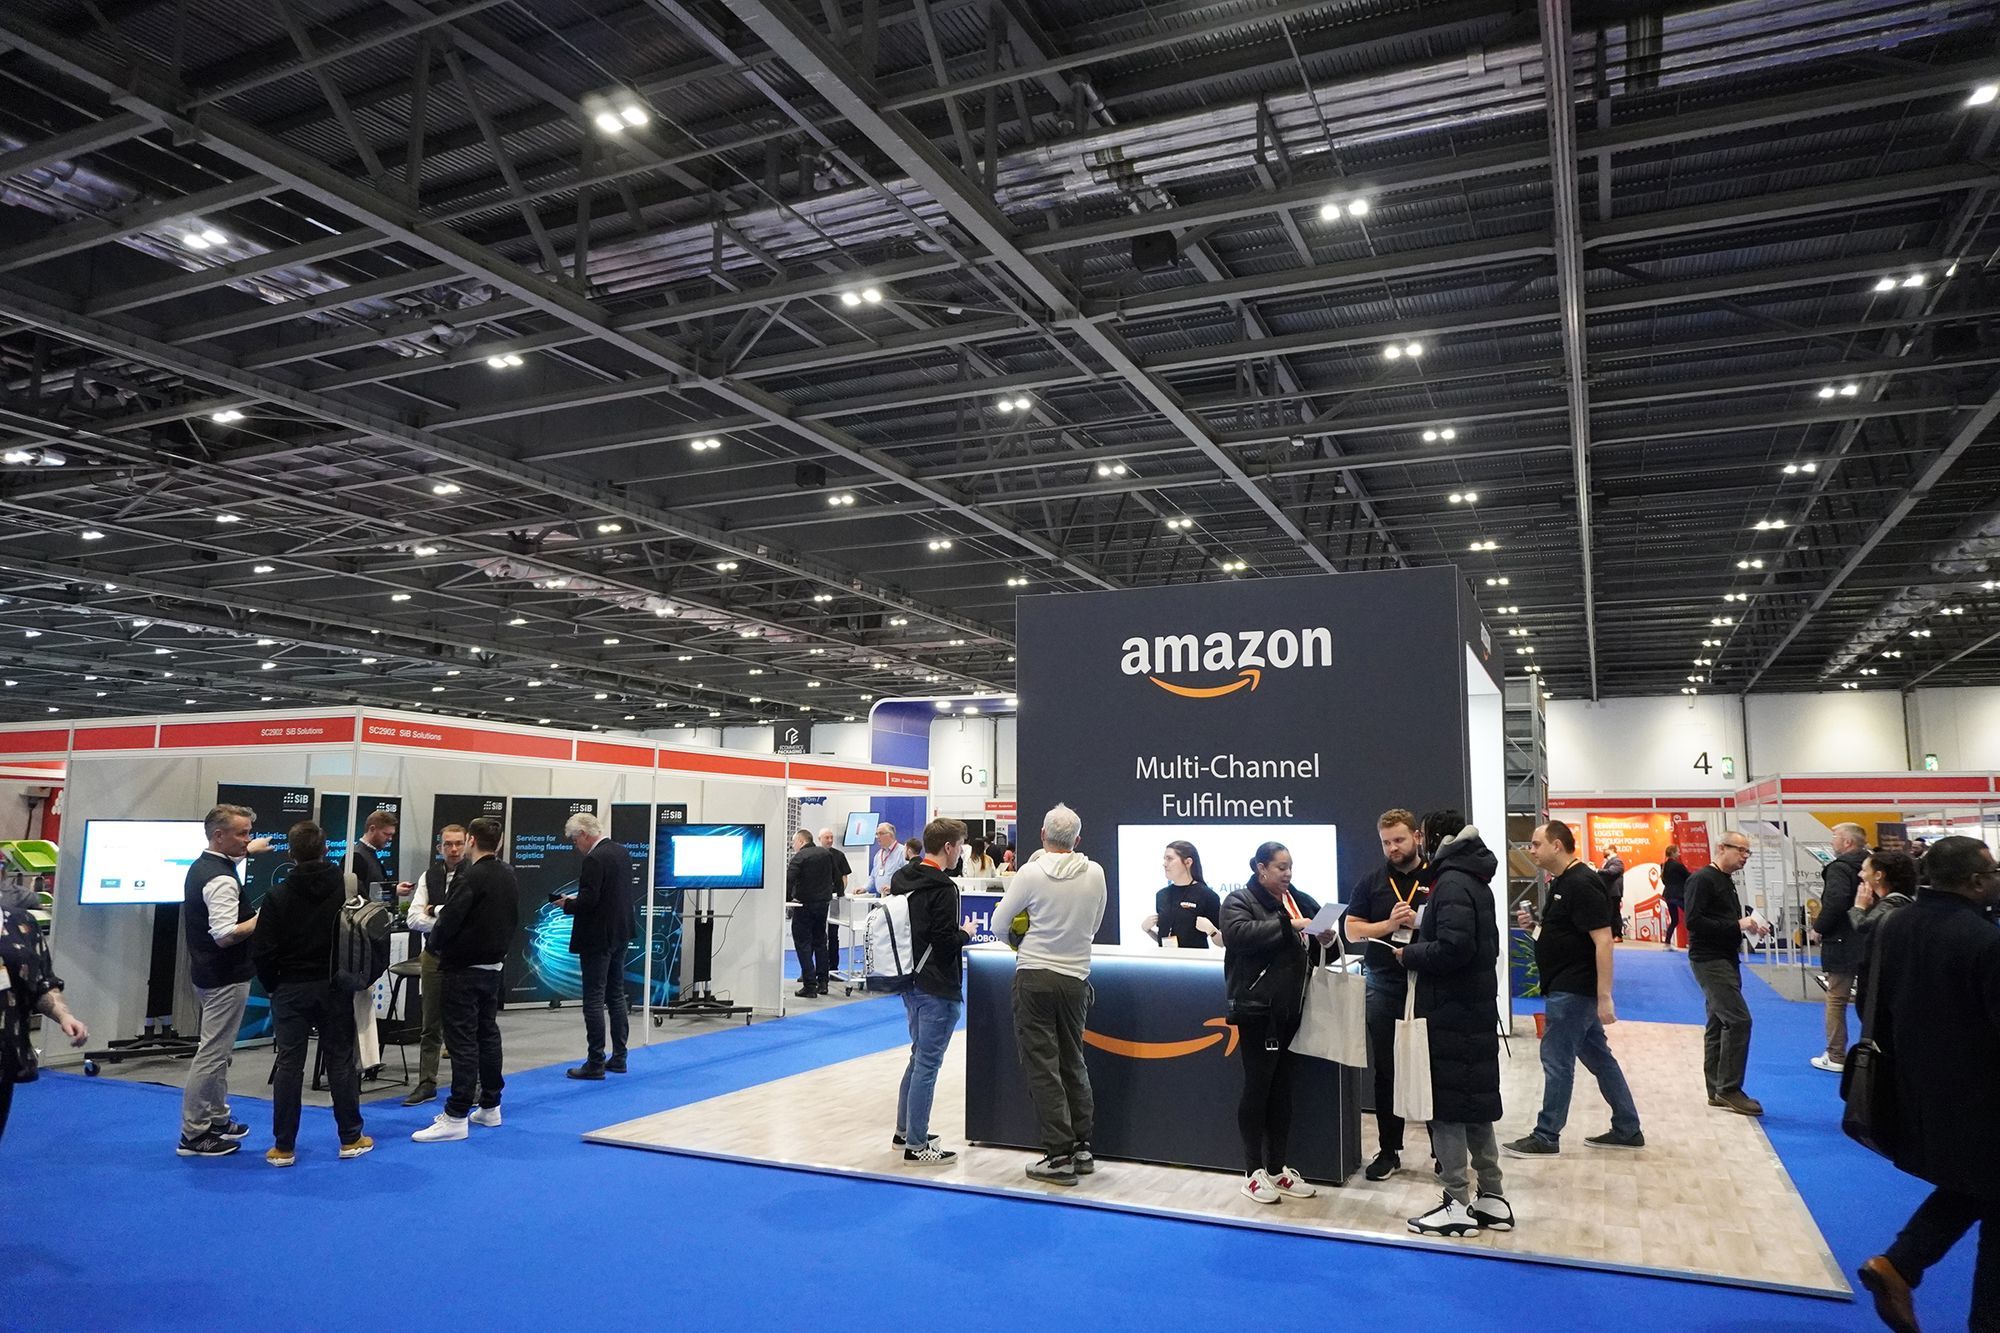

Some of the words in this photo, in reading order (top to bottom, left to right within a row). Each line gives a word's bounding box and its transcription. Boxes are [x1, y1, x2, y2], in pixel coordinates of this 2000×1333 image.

[1120, 627, 1332, 676] amazon
[261, 728, 283, 736] SC2902
[297, 727, 324, 736] Solutions
[368, 726, 396, 736] SC2902
[412, 731, 442, 741] Solutions
[1136, 753, 1320, 779] Multi-Channel
[1693, 751, 1713, 775] 4
[961, 765, 973, 785] 6
[294, 795, 309, 804] SiB
[385, 803, 397, 812] SiB
[492, 802, 503, 811] SiB
[579, 804, 593, 812] SiB
[1162, 792, 1294, 818] Fulfilment
[670, 811, 682, 819] SiB
[516, 834, 545, 842] Services
[515, 843, 545, 852] enabling
[515, 852, 545, 860] logistics
